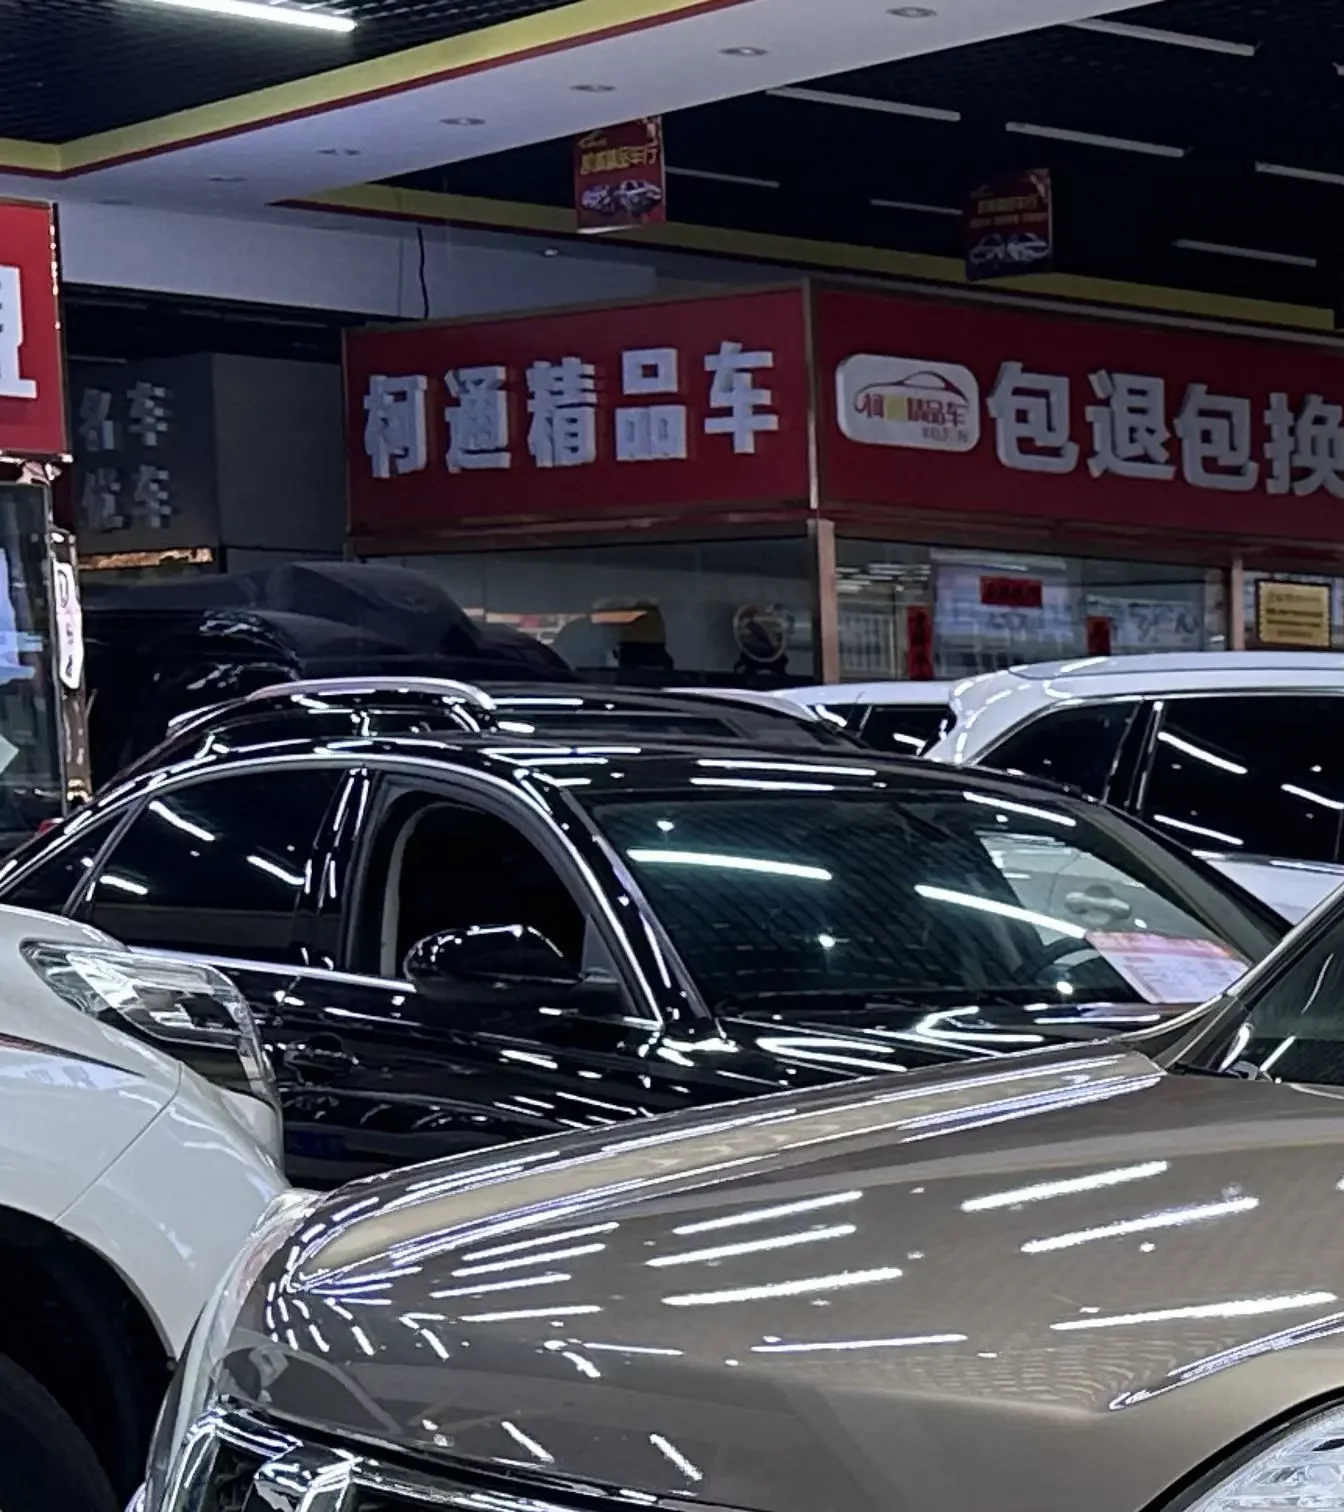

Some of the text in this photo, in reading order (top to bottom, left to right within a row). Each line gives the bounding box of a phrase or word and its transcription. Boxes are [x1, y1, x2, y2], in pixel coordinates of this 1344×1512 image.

[363, 340, 779, 479] 柯通精品车
